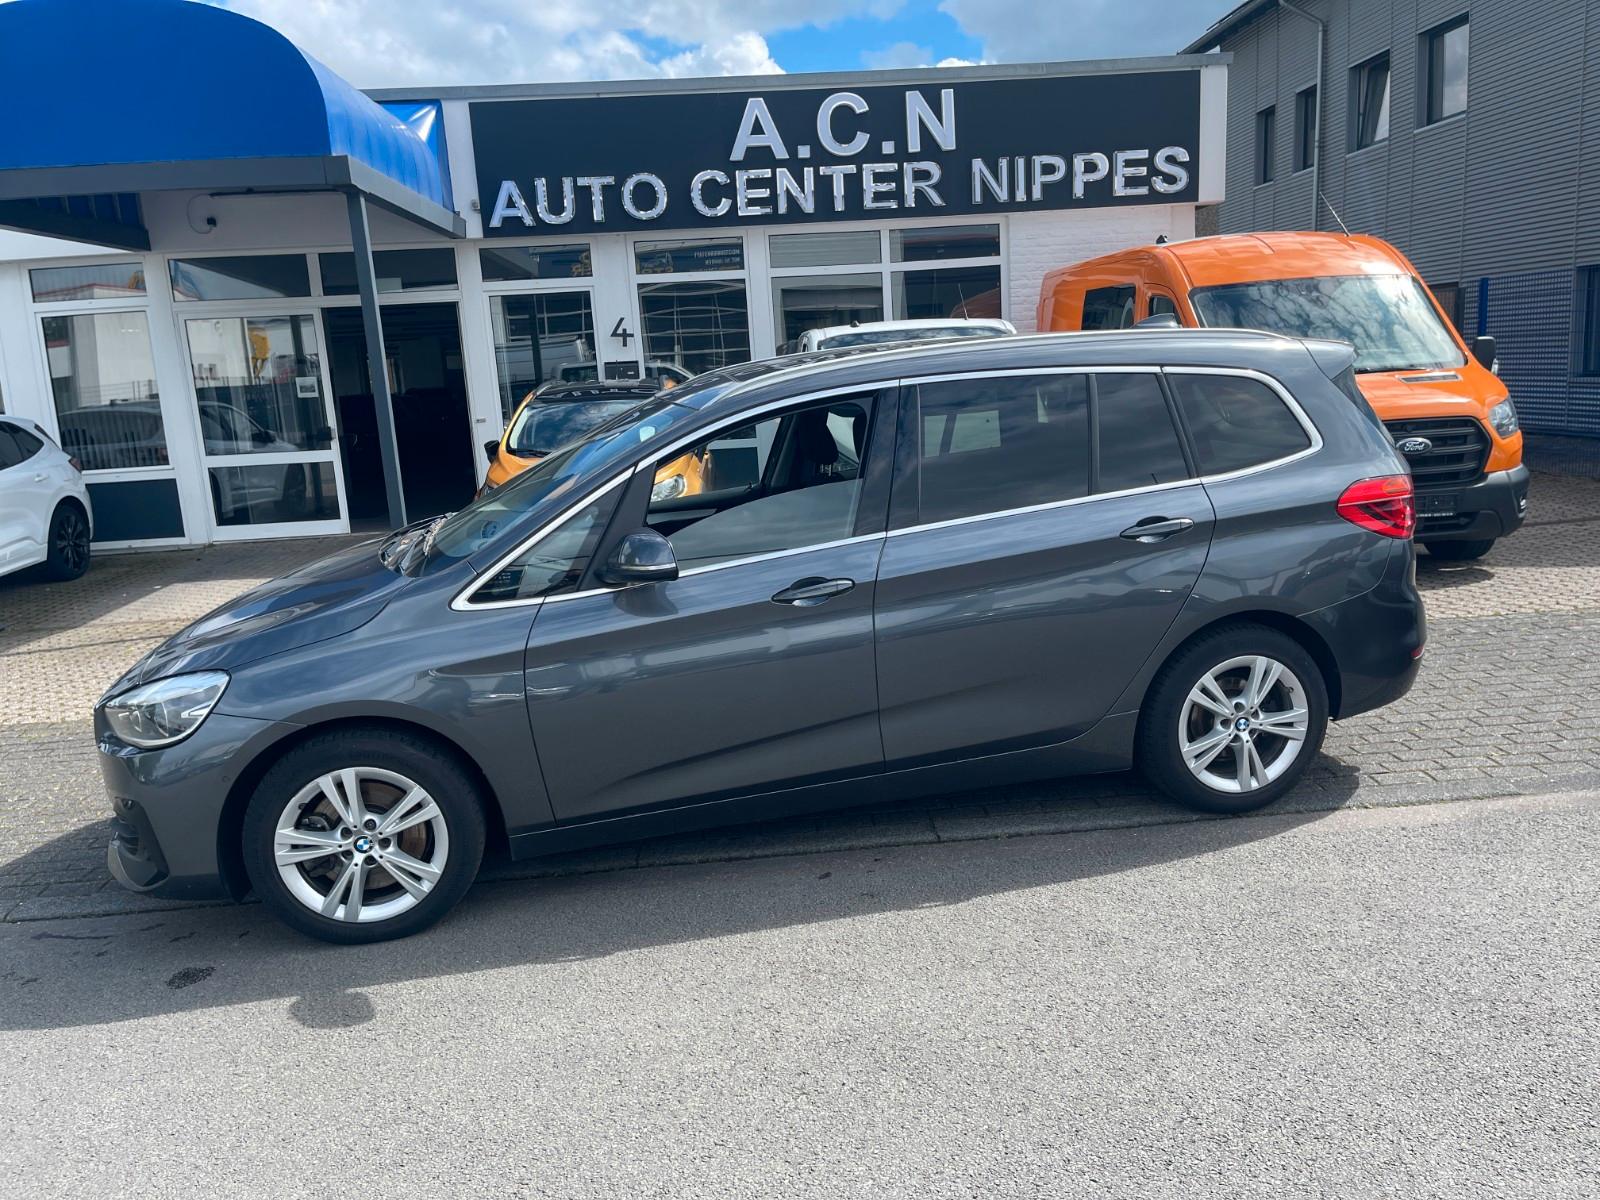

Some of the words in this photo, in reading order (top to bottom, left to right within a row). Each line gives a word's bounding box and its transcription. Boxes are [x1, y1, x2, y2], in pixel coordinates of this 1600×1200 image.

[729, 88, 957, 161] A.C.N
[488, 172, 668, 228] AUTO
[690, 160, 946, 217] CENTER
[971, 146, 1190, 205] NIPPES
[610, 317, 634, 347] 4
[1404, 440, 1425, 451] Ford
